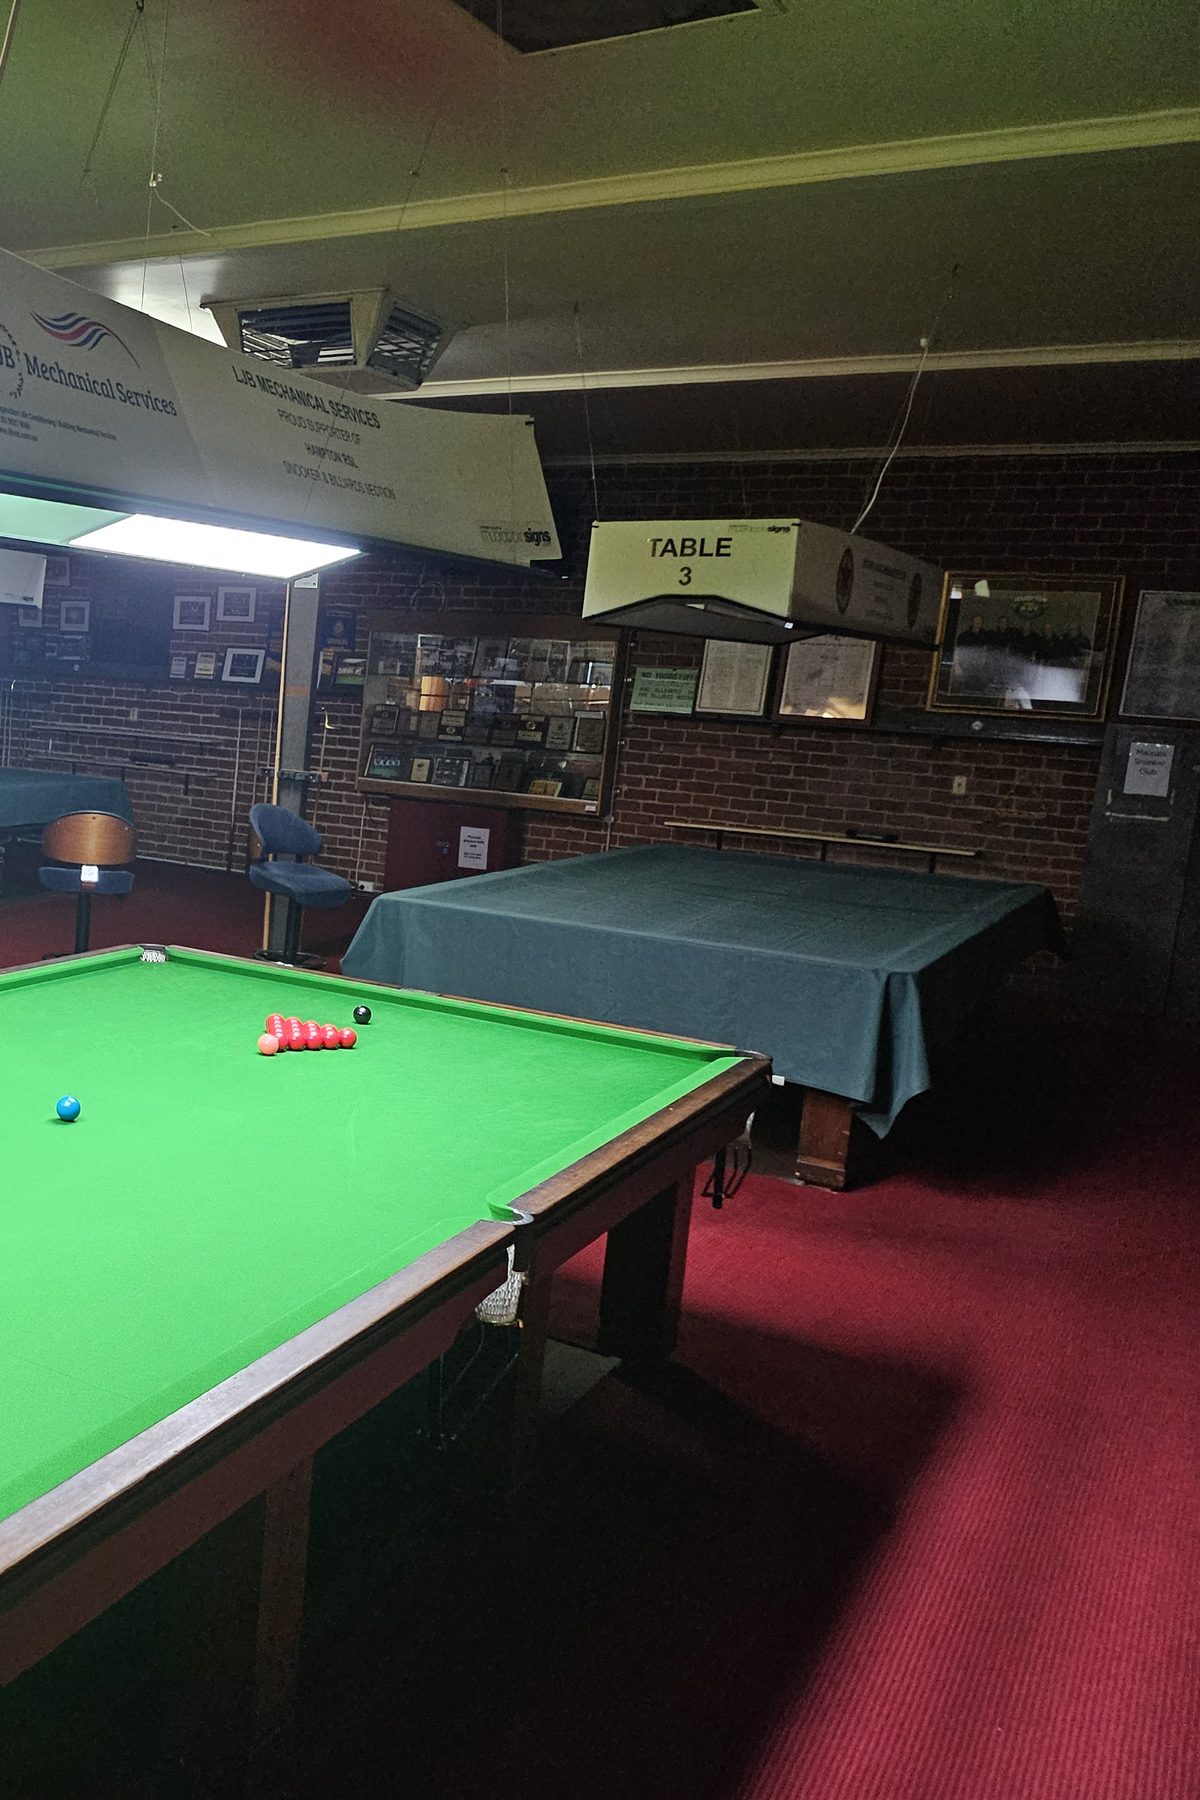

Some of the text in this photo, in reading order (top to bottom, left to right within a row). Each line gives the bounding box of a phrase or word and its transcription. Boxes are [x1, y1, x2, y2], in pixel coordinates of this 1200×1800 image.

[23, 352, 178, 417] Mechanical Services
[231, 365, 381, 429] LJB MECHANICAL SERVICES
[277, 409, 361, 446] PROUD SUPPORTER OF
[304, 442, 358, 469] HAMPTON RSL
[283, 459, 322, 482] SNOOKER
[322, 472, 330, 486] &
[364, 483, 397, 501] SECTION
[648, 537, 733, 558] TABLE
[678, 566, 692, 586] 3
